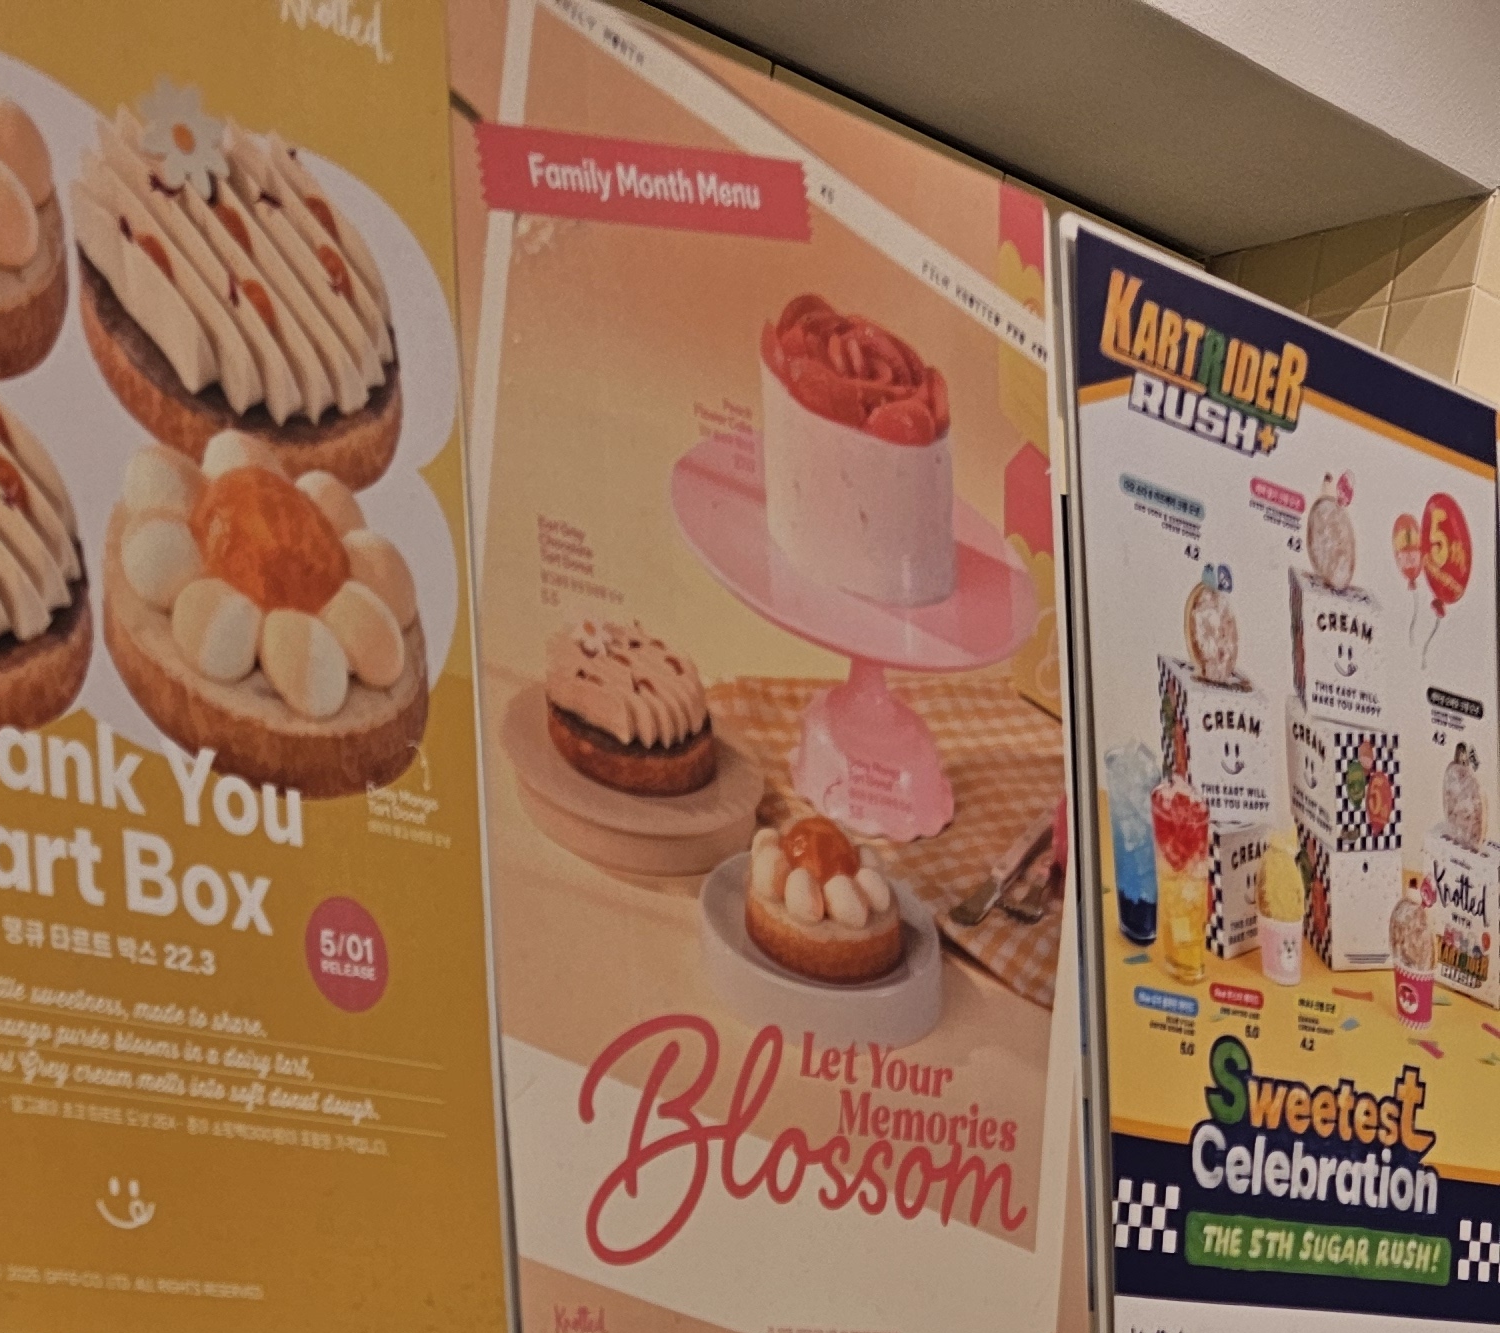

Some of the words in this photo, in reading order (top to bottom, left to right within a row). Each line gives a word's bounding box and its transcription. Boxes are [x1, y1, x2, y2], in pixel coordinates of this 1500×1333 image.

[528, 151, 613, 202] Family
[616, 161, 694, 204] Month
[698, 172, 762, 211] Menu
[1102, 268, 1309, 426] KARTRIDER
[1316, 611, 1374, 643] CREAM
[1202, 710, 1262, 738] CREAM
[1292, 722, 1326, 760] CREAM
[165, 744, 304, 848] You
[125, 825, 275, 936] Box
[1433, 859, 1490, 928] Knotted
[50, 922, 113, 959] 타르트
[117, 934, 157, 965] 박스
[318, 928, 375, 966] 5/01
[1451, 911, 1473, 929] WITH
[319, 957, 378, 982] RELEASE
[133, 1002, 186, 1026] made
[800, 1030, 859, 1082] Let
[867, 1041, 953, 1099] Your
[1204, 1035, 1436, 1153] Sweetest
[577, 1013, 1028, 1266] Blossom
[836, 1088, 1017, 1153] Memories
[1191, 1123, 1439, 1216] Celebration
[1202, 1224, 1243, 1259] THE
[1248, 1227, 1295, 1260] 5TH
[1299, 1230, 1369, 1267] SUGAR
[1375, 1237, 1442, 1274] RUSH!
